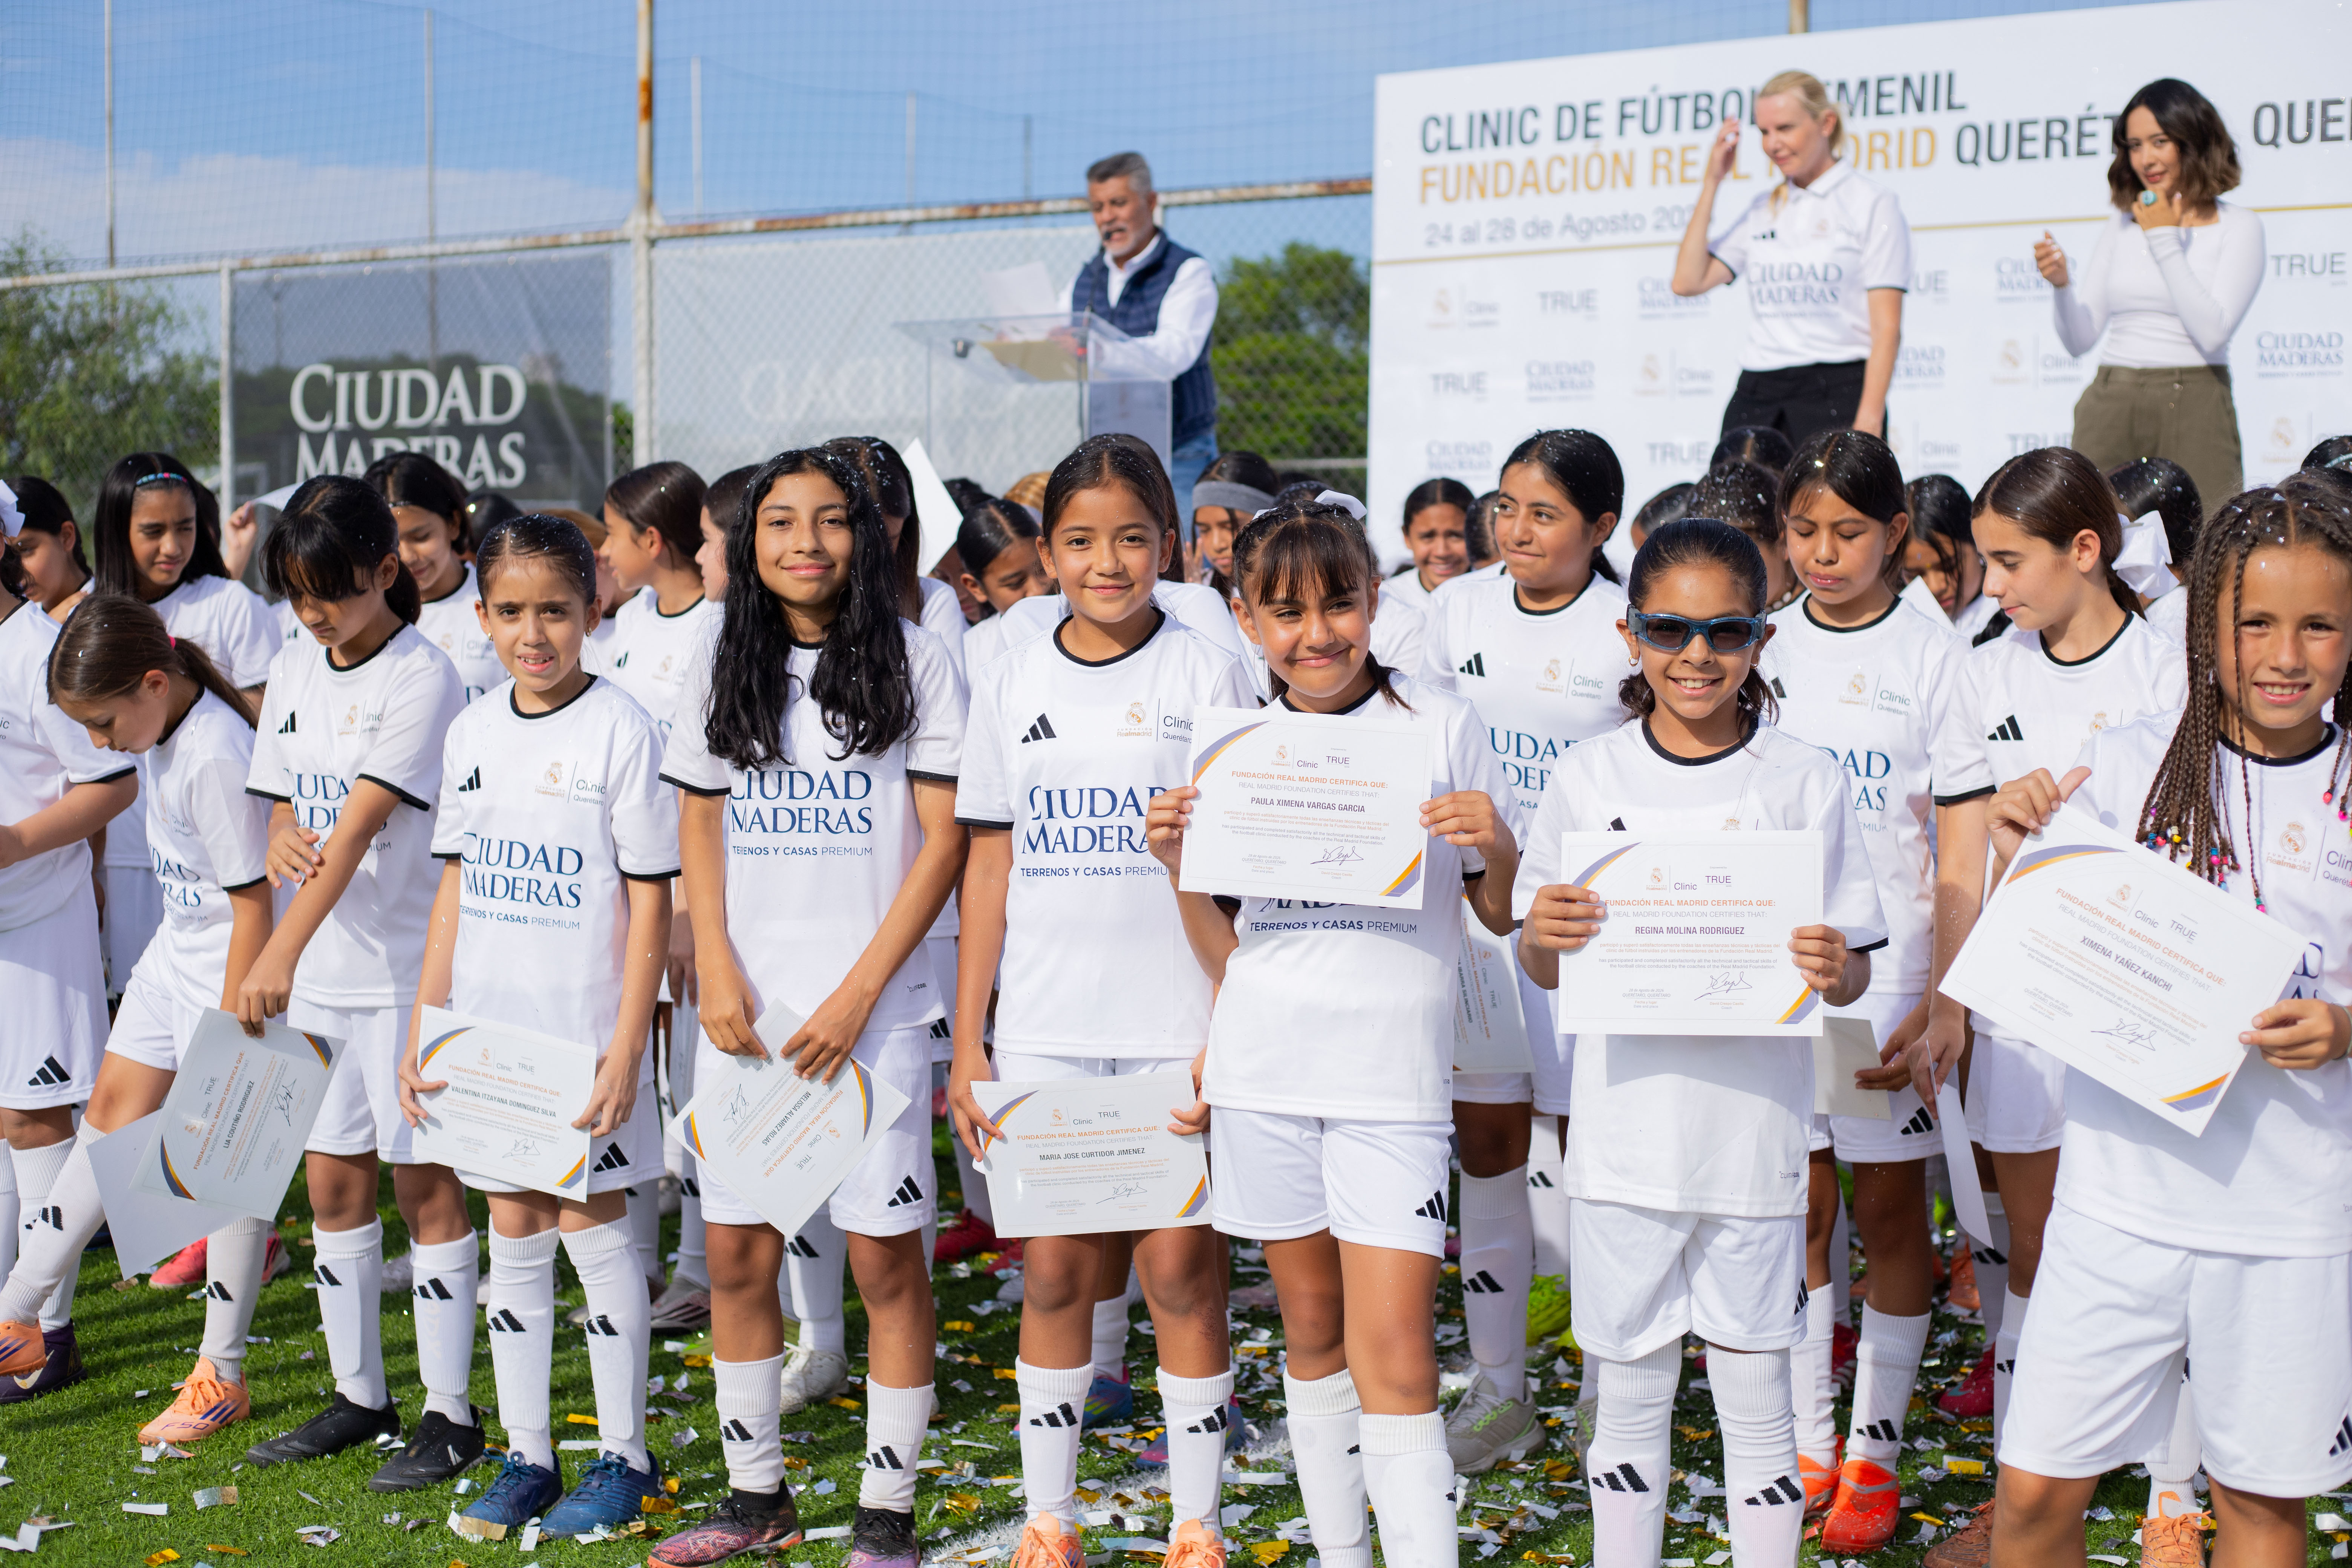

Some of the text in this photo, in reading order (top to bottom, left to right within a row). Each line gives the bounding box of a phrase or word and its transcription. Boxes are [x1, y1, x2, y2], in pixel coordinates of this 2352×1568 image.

[1422, 107, 1539, 153] CLINIC
[1556, 102, 1602, 141] DE
[1824, 69, 1966, 117] MENIL
[2253, 99, 2352, 148] QUE
[1420, 141, 1634, 204] FUNDACIÓN
[1651, 145, 1750, 185] REL
[1956, 104, 2121, 166] QUERÉT
[1424, 222, 1453, 248] 24
[1459, 219, 1481, 244] al
[1485, 216, 1517, 243] 28
[1522, 214, 1554, 240] de
[1559, 210, 1647, 242] Agosto
[1747, 263, 1843, 285] CIUDAD
[2270, 252, 2348, 277] TRUE
[1538, 289, 1598, 313] TRUE
[2257, 331, 2344, 351] CIUDAD
[2258, 351, 2344, 368] MADERAS
[1430, 371, 1488, 394] TRUE
[289, 363, 528, 433] CIUDAD
[1646, 441, 1709, 464] TRUE
[1573, 675, 1604, 689] Clinic
[1571, 690, 1602, 700] Querétaro
[1880, 689, 1911, 706] Clinic
[1877, 704, 1909, 717] Querétaro
[1297, 760, 1318, 768] Clinic
[1325, 756, 1349, 764] TRUE
[576, 779, 606, 795] Clinic
[731, 767, 871, 800] CIUDAD
[1231, 770, 1274, 779] FUNDACIÓN
[1329, 778, 1368, 787] CERTIFICA
[534, 788, 565, 798] Realmadrid
[573, 794, 604, 806] Querétaro
[1251, 797, 1365, 812] PAULA XIMENA VARGAS GARCIA
[732, 803, 872, 835] MADERAS
[1022, 822, 1150, 854] MADER
[461, 832, 583, 876] CIUDAD
[733, 846, 872, 856] TERRENOS Y CASAS PREMIUM
[2267, 852, 2312, 866] FUNDACIÓN
[2326, 850, 2352, 868] Clin
[1021, 867, 1168, 877] TERRENOS Y CASAS PREMIU
[2266, 856, 2311, 873] Realmadrid
[463, 866, 582, 909] MADERAS
[2323, 870, 2352, 887] Queréta
[459, 905, 486, 919] TERRENOS
[496, 913, 528, 924] CASAS
[531, 917, 580, 930] PREMIUM
[1250, 922, 1308, 931] TERRENOS
[1322, 920, 1363, 930] CASAS
[1367, 921, 1417, 934] PREMIUM
[2133, 909, 2160, 928] Clinic
[2168, 919, 2198, 940] TRUE
[2080, 936, 2173, 992] XIMENA YAÑEZ KANCHI
[451, 1085, 556, 1118] VALENTINA ITZAYANA DOMINGUEZ SILVA
[223, 1080, 255, 1148] LIA COUTIÑO RODRIGUEZ
[761, 1090, 811, 1146] MELISSA ALVAREZ ROJAS
[807, 1133, 822, 1149] Clinic
[796, 1153, 812, 1170] TRUE
[161, 1422, 209, 1431] F50
